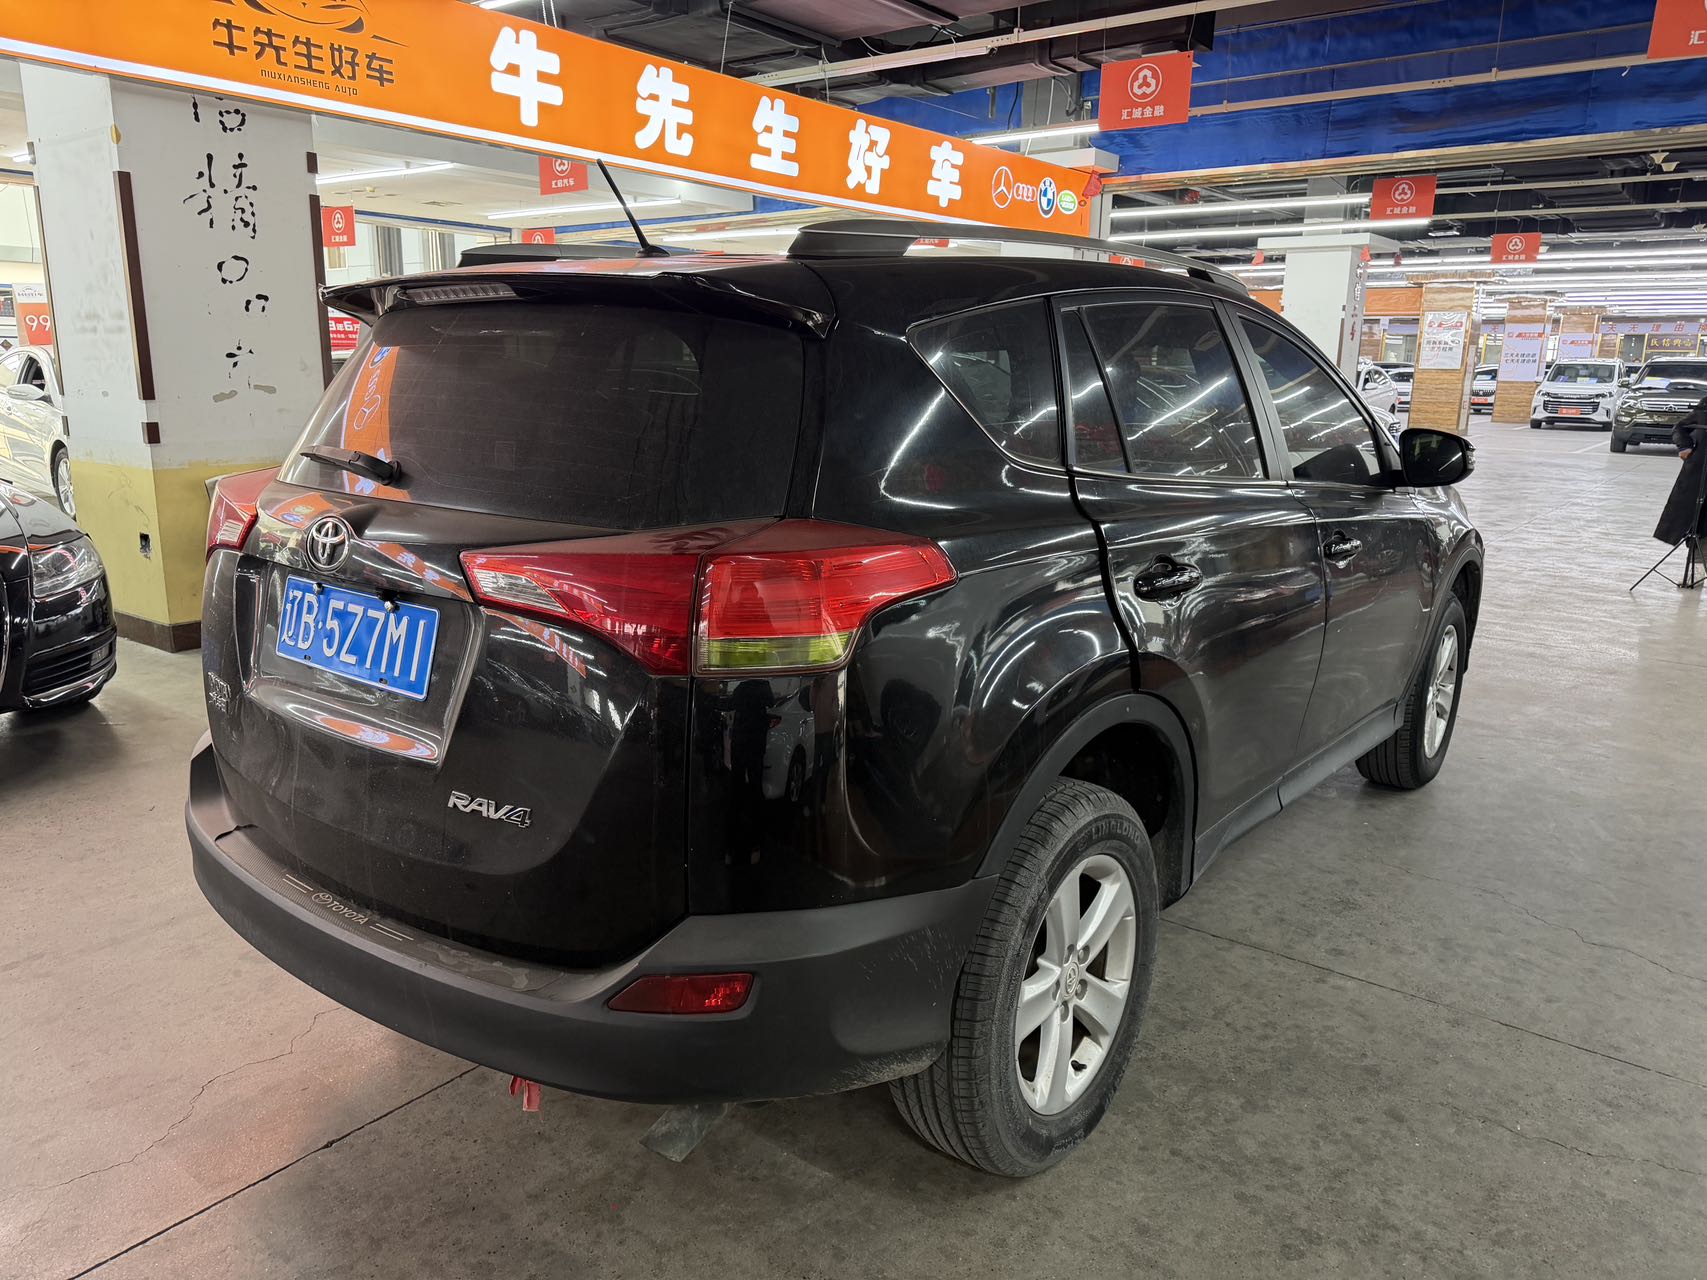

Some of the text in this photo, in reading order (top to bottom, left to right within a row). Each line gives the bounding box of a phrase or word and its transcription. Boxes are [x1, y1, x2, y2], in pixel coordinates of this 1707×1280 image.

[212, 17, 395, 88] 牛先生好车
[260, 69, 358, 97] NIUXIANSHENG AUTO
[489, 25, 964, 208] 牛先生好车
[1121, 105, 1165, 120] 汇城金融
[448, 790, 532, 828] RAV4
[327, 900, 369, 925] TOYOTA
